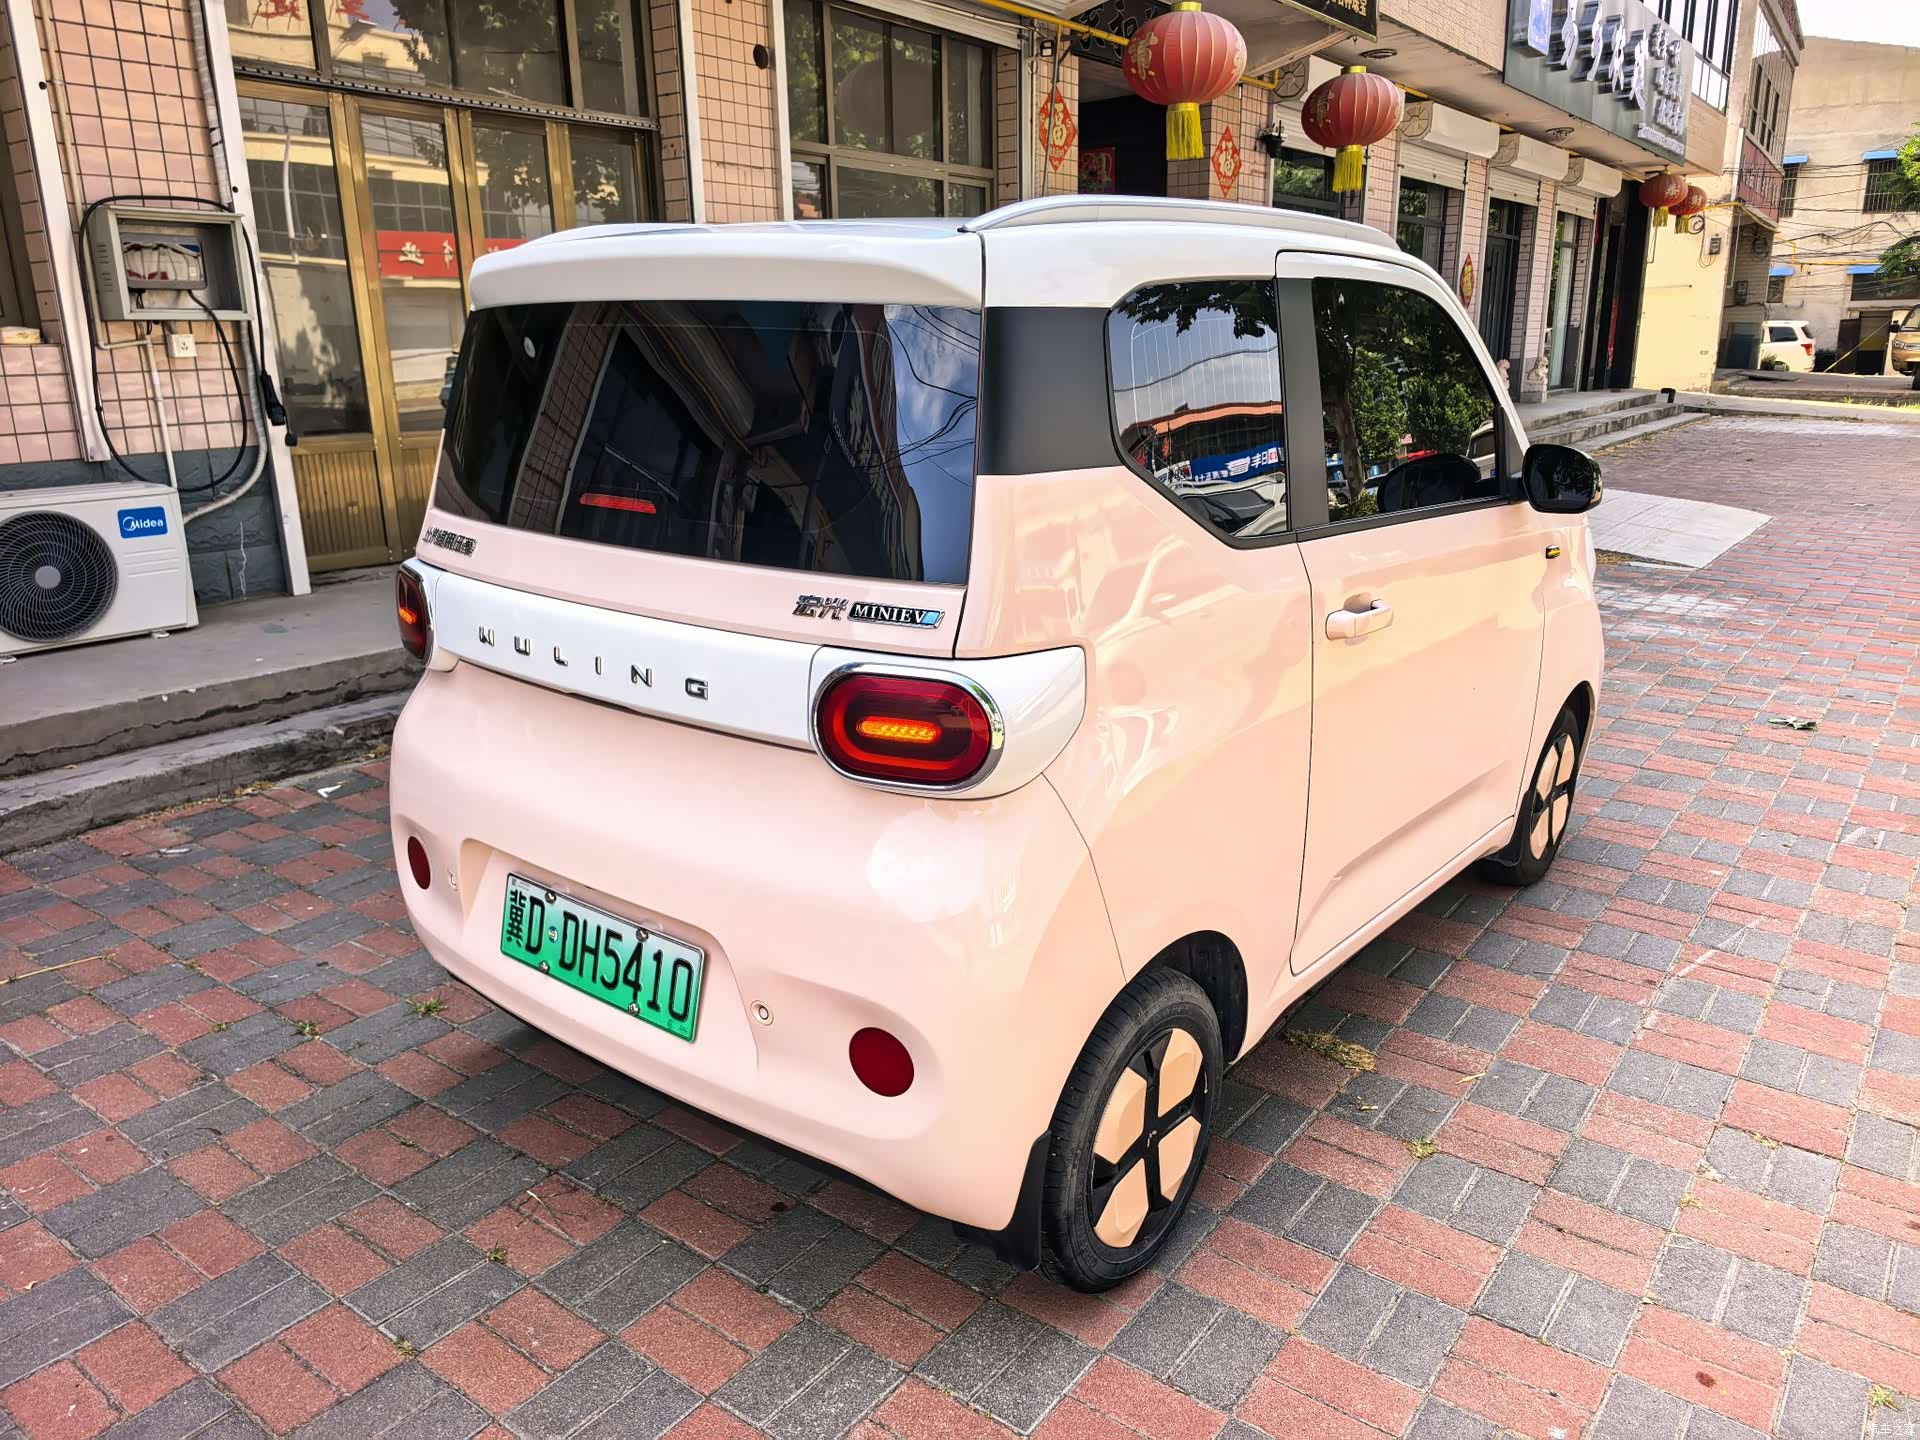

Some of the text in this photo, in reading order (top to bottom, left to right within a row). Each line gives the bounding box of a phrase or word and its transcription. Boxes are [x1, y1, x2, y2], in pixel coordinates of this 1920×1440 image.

[1219, 140, 1235, 178] 福
[124, 516, 164, 531] Midea
[793, 594, 927, 625] 宏光 MINIEV
[478, 625, 709, 700] WULING
[506, 889, 695, 1022] 冀D DH5410
